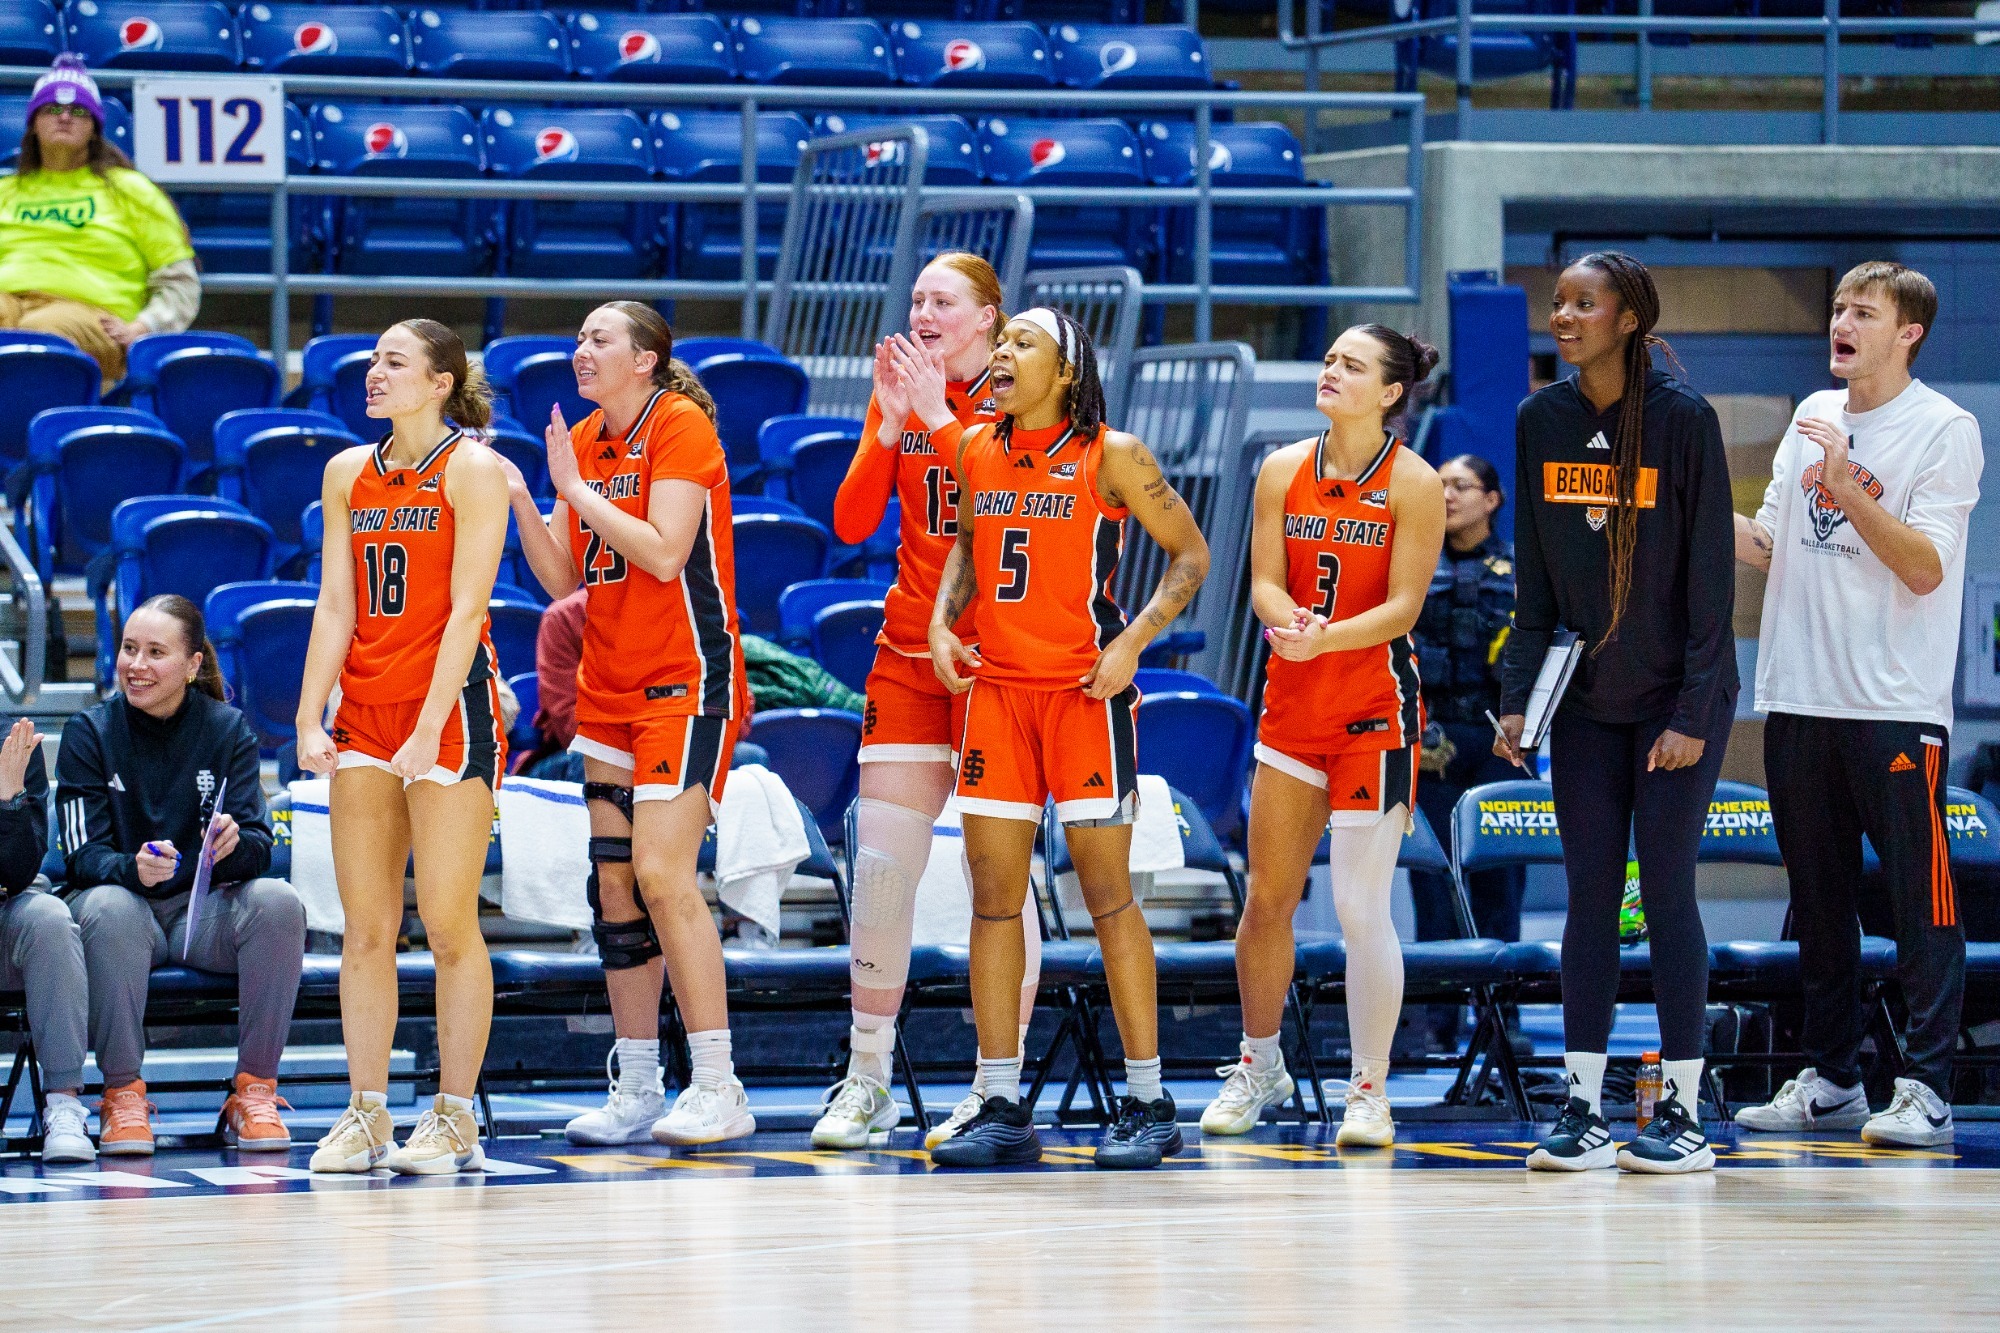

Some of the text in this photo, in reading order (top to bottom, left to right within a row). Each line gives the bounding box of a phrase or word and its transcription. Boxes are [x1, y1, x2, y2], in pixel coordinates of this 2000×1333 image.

[156, 97, 264, 163] 112
[974, 490, 1077, 519] IDAHO STATE
[351, 506, 441, 534] DAHO STATE
[1332, 518, 1389, 547] STATE
[1815, 541, 1860, 555] BASKETBALL
[995, 527, 1030, 602] 5
[364, 542, 408, 617] 18
[1311, 552, 1341, 621] 3
[1889, 762, 1917, 773] adidas
